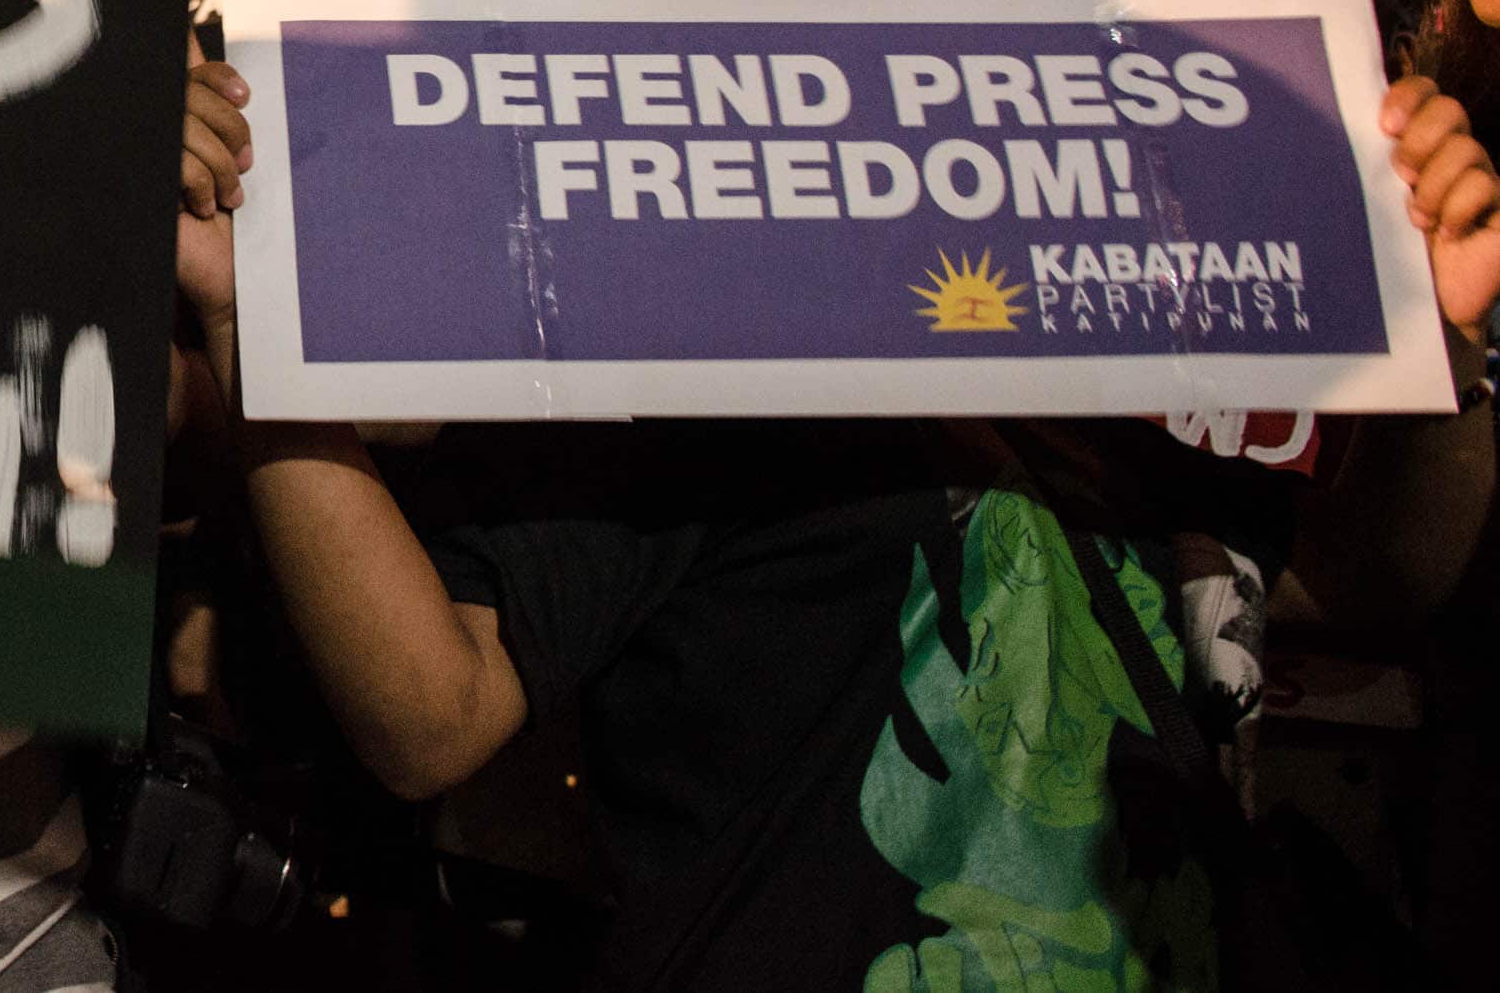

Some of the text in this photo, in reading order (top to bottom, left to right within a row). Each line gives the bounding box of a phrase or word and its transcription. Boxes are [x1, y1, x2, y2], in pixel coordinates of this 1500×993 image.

[386, 52, 1249, 127] DEFEND PRESS
[535, 139, 1140, 221] FREEDOM!
[1028, 241, 1303, 285] KABATAAN
[1036, 282, 1306, 316] PARTYLIST
[1040, 312, 1313, 335] KATIPUNAN
